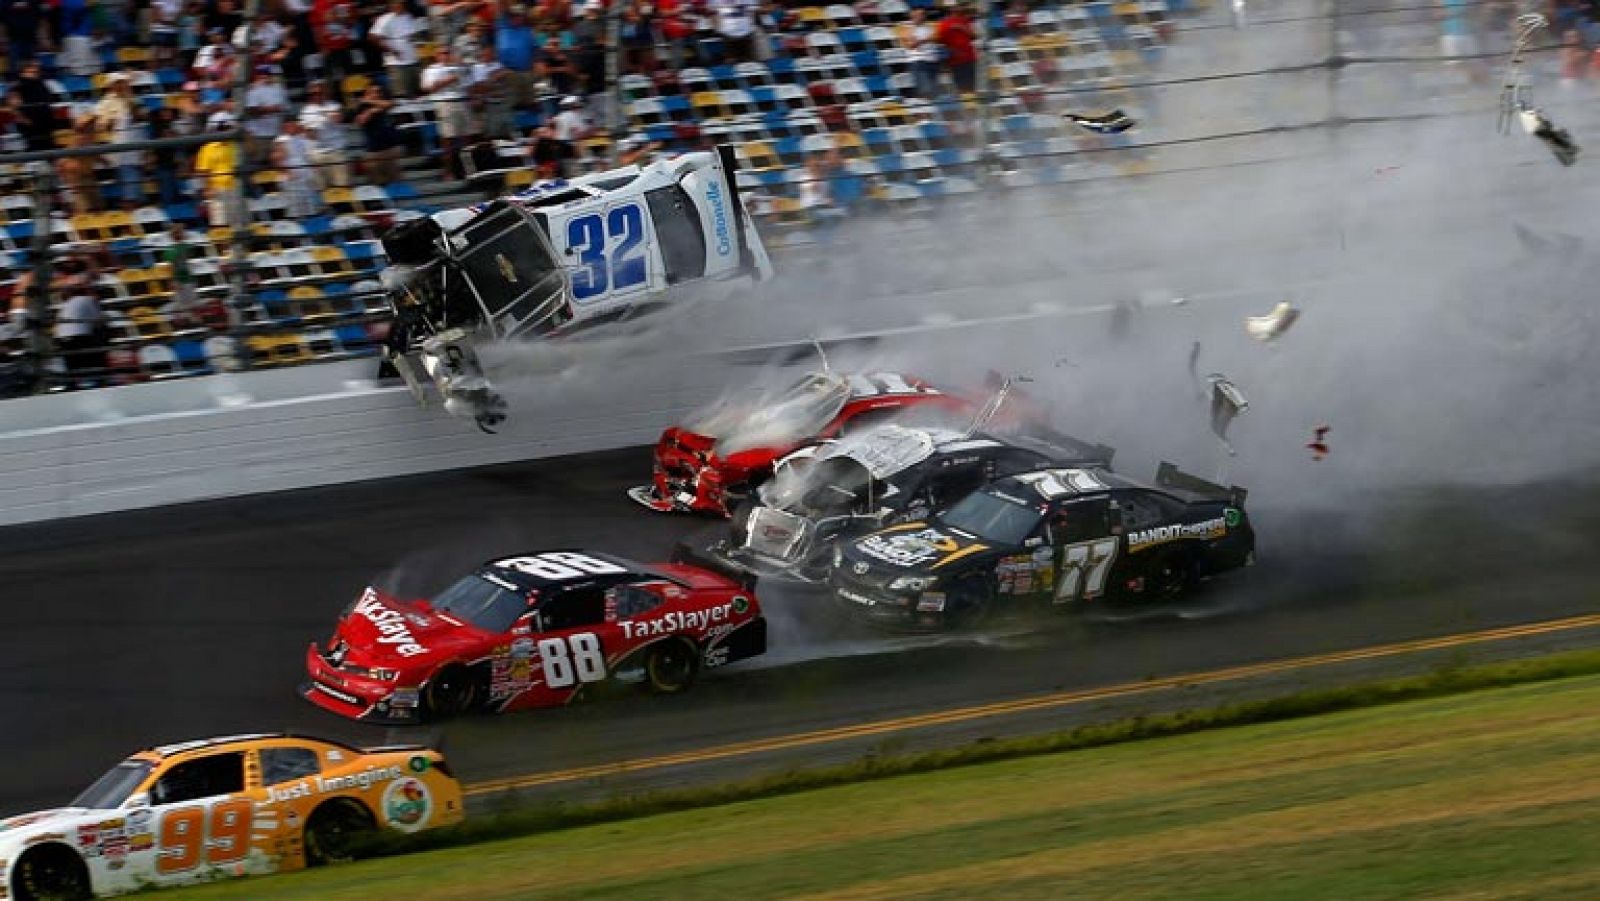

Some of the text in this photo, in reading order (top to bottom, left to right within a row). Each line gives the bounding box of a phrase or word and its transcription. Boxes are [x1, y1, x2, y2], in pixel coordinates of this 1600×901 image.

[568, 204, 646, 299] 32
[1012, 469, 1111, 501] 77
[493, 552, 628, 580] 88
[1054, 536, 1119, 602] 77
[616, 604, 732, 638] TaxSlayer
[537, 632, 607, 688] 88
[265, 778, 311, 801] Just
[155, 800, 253, 875] 99
